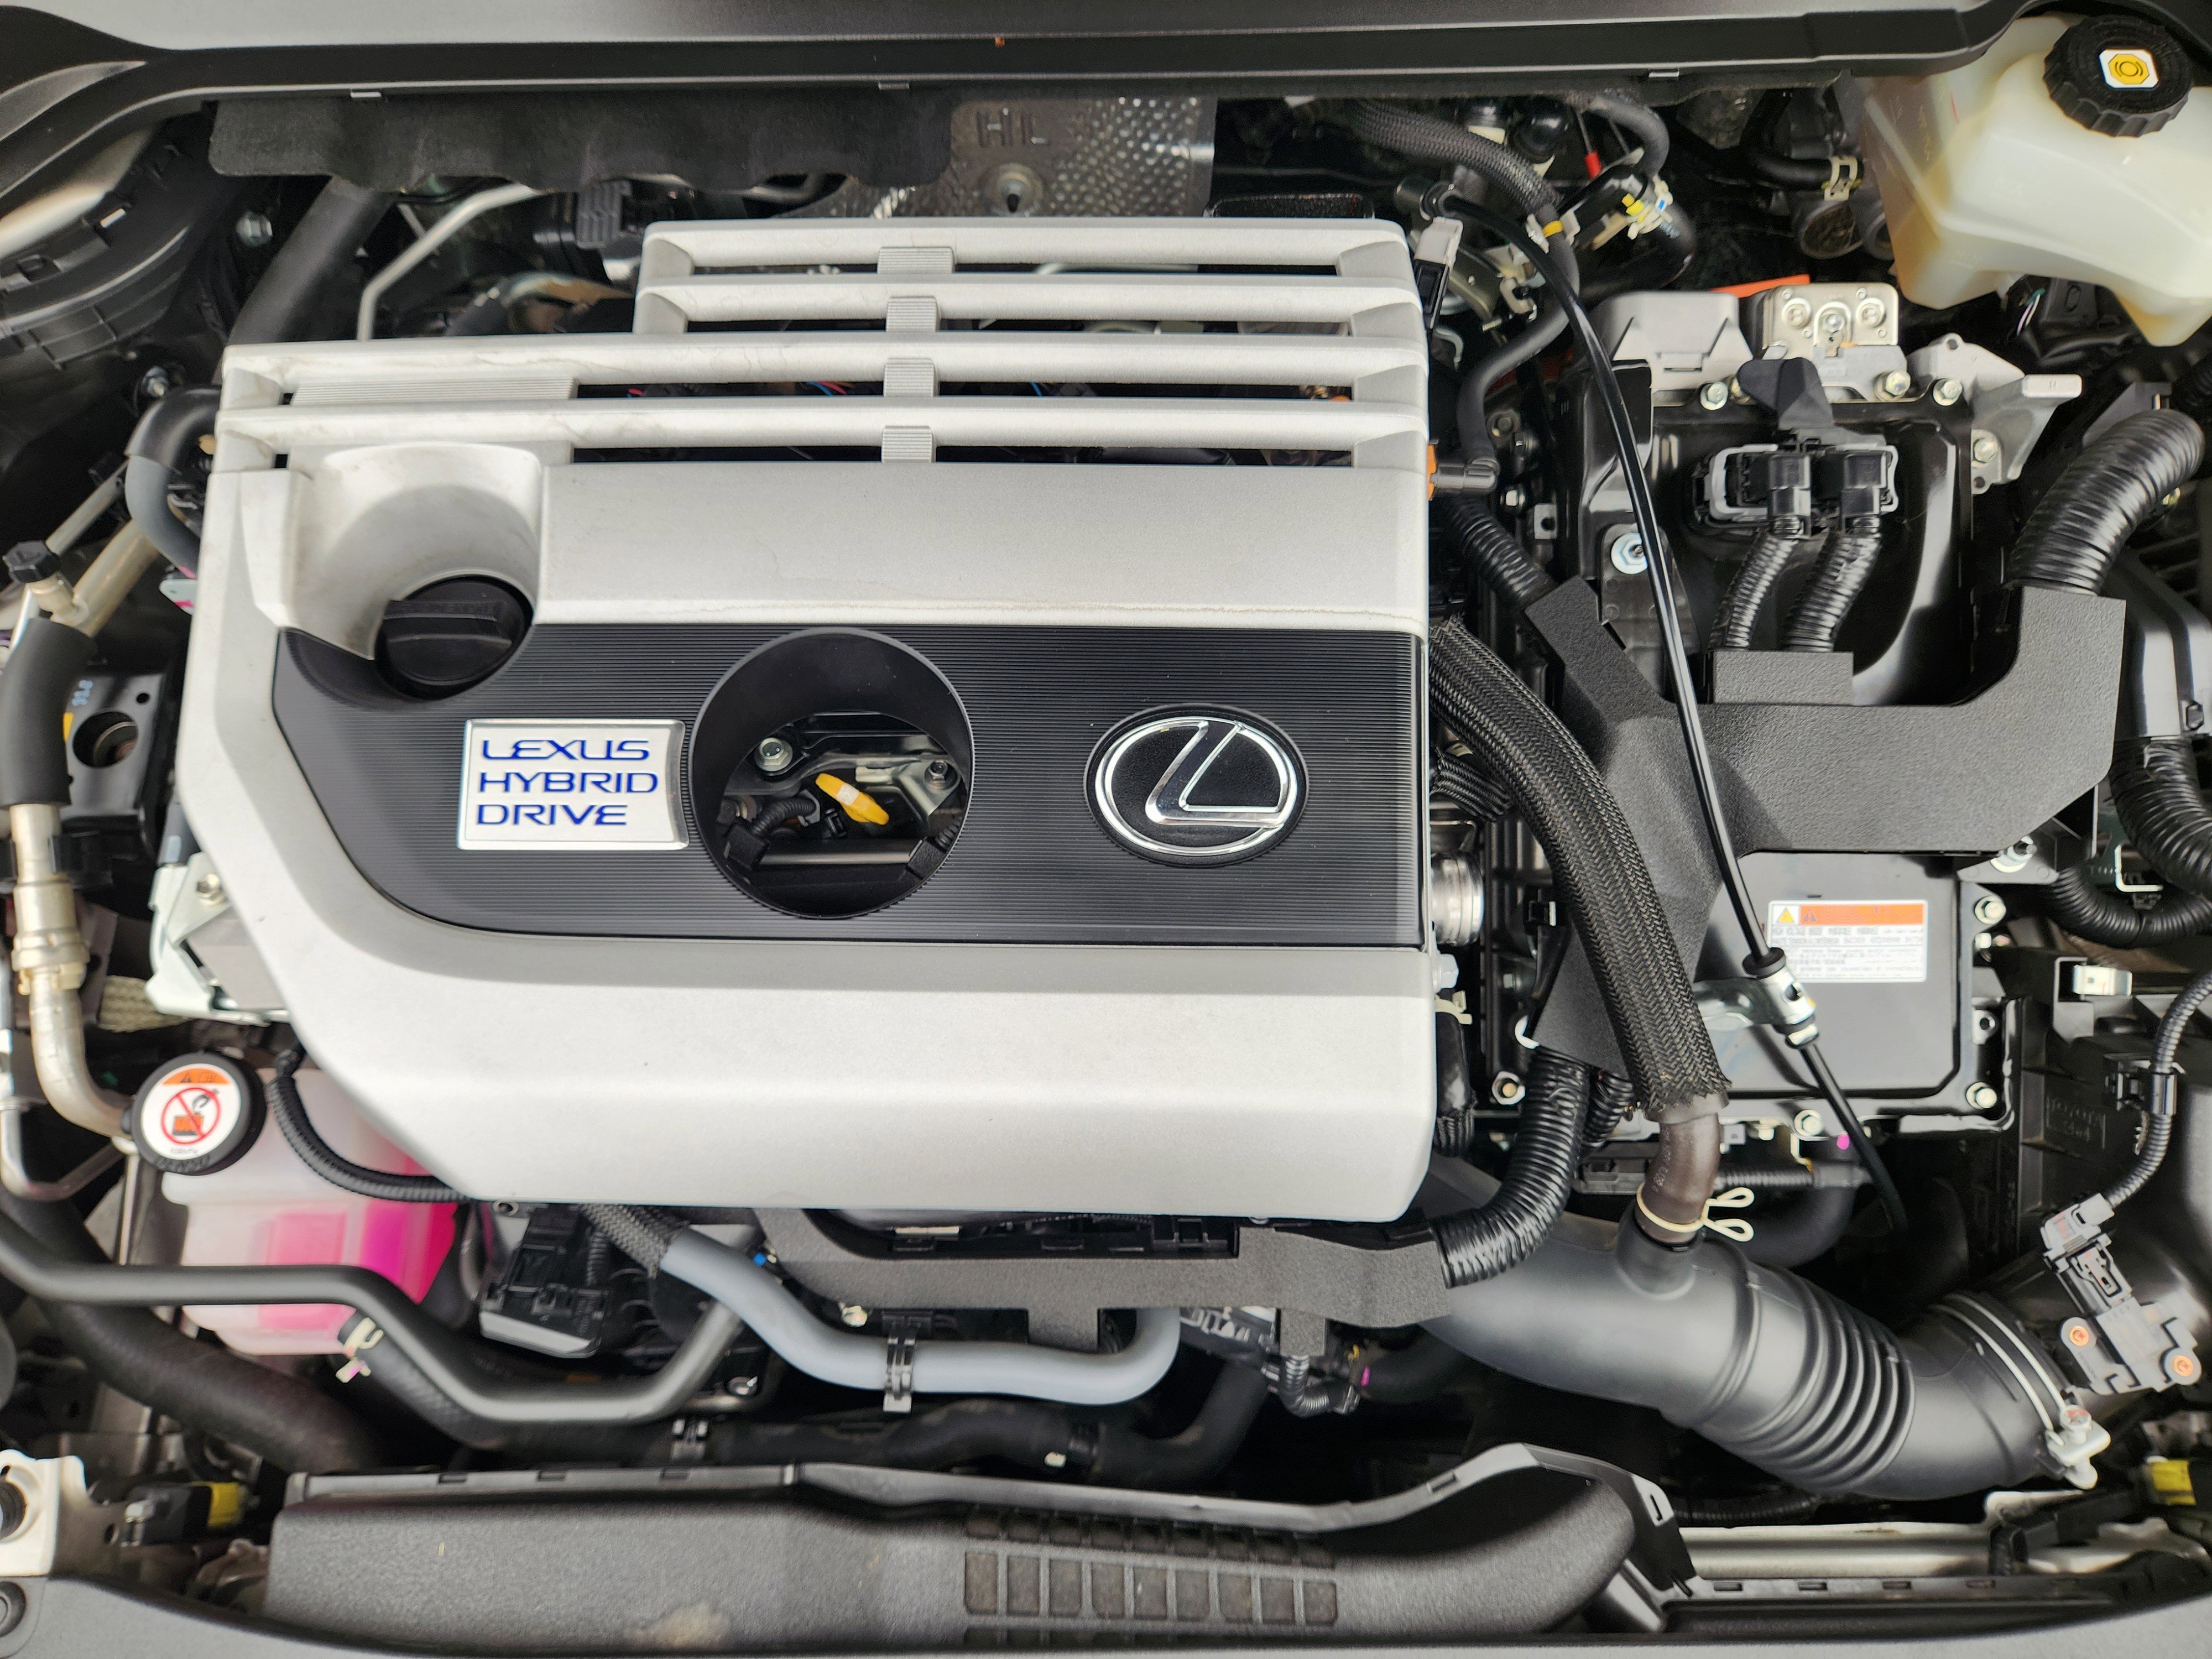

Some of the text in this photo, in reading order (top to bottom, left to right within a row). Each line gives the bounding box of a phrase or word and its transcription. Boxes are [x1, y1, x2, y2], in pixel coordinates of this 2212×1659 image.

[482, 739, 650, 761] LEXUS
[478, 771, 659, 793] HYBRID
[476, 804, 629, 826] DRIVE
